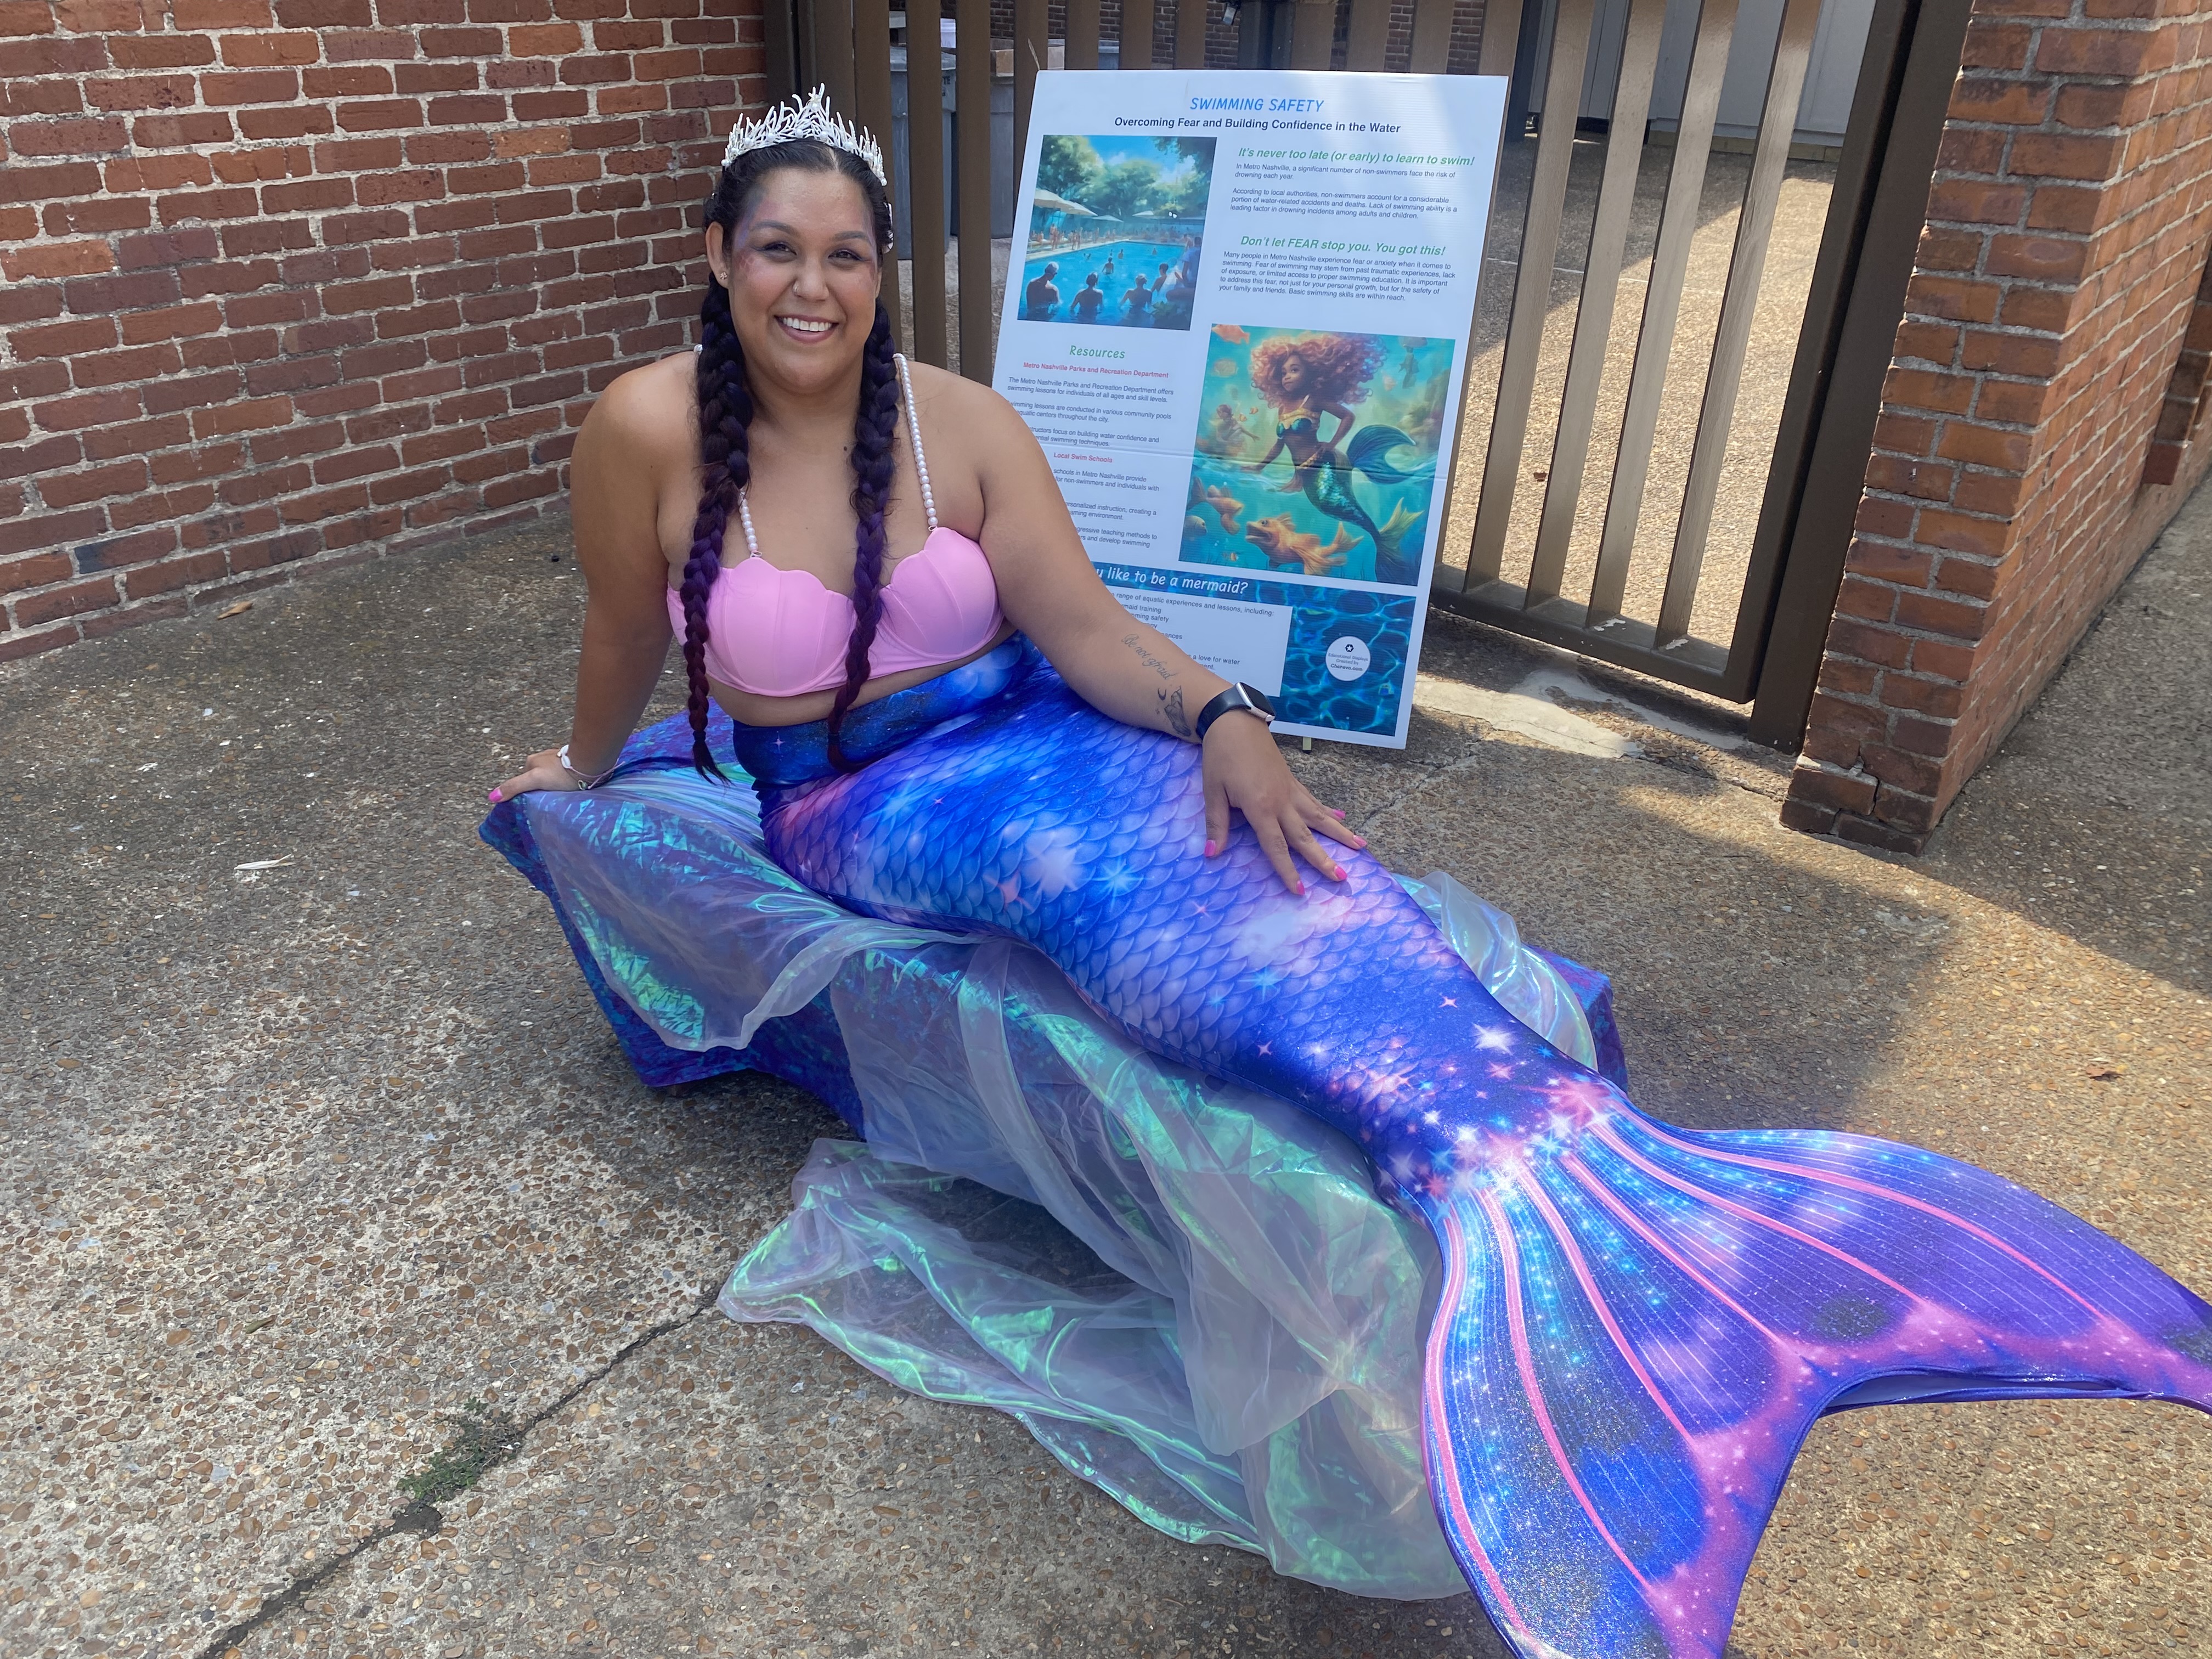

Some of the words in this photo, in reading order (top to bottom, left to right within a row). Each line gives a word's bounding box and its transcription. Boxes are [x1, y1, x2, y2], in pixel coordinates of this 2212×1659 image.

[1190, 97, 1264, 111] SWIMMING
[1268, 98, 1324, 112] SAFETY
[1115, 117, 1175, 129] Overcoming
[1178, 117, 1200, 127] Fear
[1203, 118, 1222, 127] and
[1225, 119, 1268, 131] Building
[1272, 120, 1333, 131] Confidence
[1335, 121, 1345, 131] in
[1349, 122, 1366, 132] the
[1369, 122, 1401, 133] Water
[1238, 147, 1255, 157] It's
[1256, 150, 1288, 158] never
[1289, 149, 1307, 159] too
[1308, 150, 1329, 160] late
[1331, 150, 1347, 162] (or
[1348, 152, 1380, 164] early)
[1382, 153, 1393, 162] to
[1396, 153, 1424, 163] learn
[1426, 155, 1438, 164] to
[1440, 155, 1475, 166] swim!
[1234, 171, 1262, 179] drowning
[1232, 188, 1262, 196] According
[1230, 204, 1252, 212] leading
[1278, 206, 1306, 215] drowning
[1240, 236, 1269, 246] Don't
[1271, 237, 1285, 247] let
[1288, 238, 1319, 249] FEAR
[1321, 240, 1345, 252] stop
[1376, 242, 1396, 253] You
[1397, 245, 1418, 256] got
[1420, 245, 1446, 256] this!
[1223, 251, 1240, 259] Many
[1289, 254, 1316, 262] Nashville
[1374, 259, 1397, 268] anxiety
[1278, 262, 1308, 271] swimming
[1233, 285, 1251, 293] family
[1307, 290, 1338, 298] swimming
[1069, 345, 1126, 359] Resources
[1100, 367, 1132, 375] Recreation
[1133, 370, 1169, 378] Department
[1007, 385, 1034, 393] swimming
[1092, 383, 1122, 391] Recreation
[1123, 385, 1156, 394] Department
[1088, 455, 1113, 463] Schools
[1099, 472, 1125, 480] Nashville
[1107, 566, 1130, 581] like
[1133, 571, 1147, 583] to
[1150, 571, 1166, 585] be
[1170, 577, 1178, 586] a
[1182, 578, 1249, 594] mermaid?
[1166, 599, 1203, 608] experiences
[1139, 605, 1162, 614] training
[1150, 615, 1170, 623] safety
[1135, 647, 1152, 658] not
